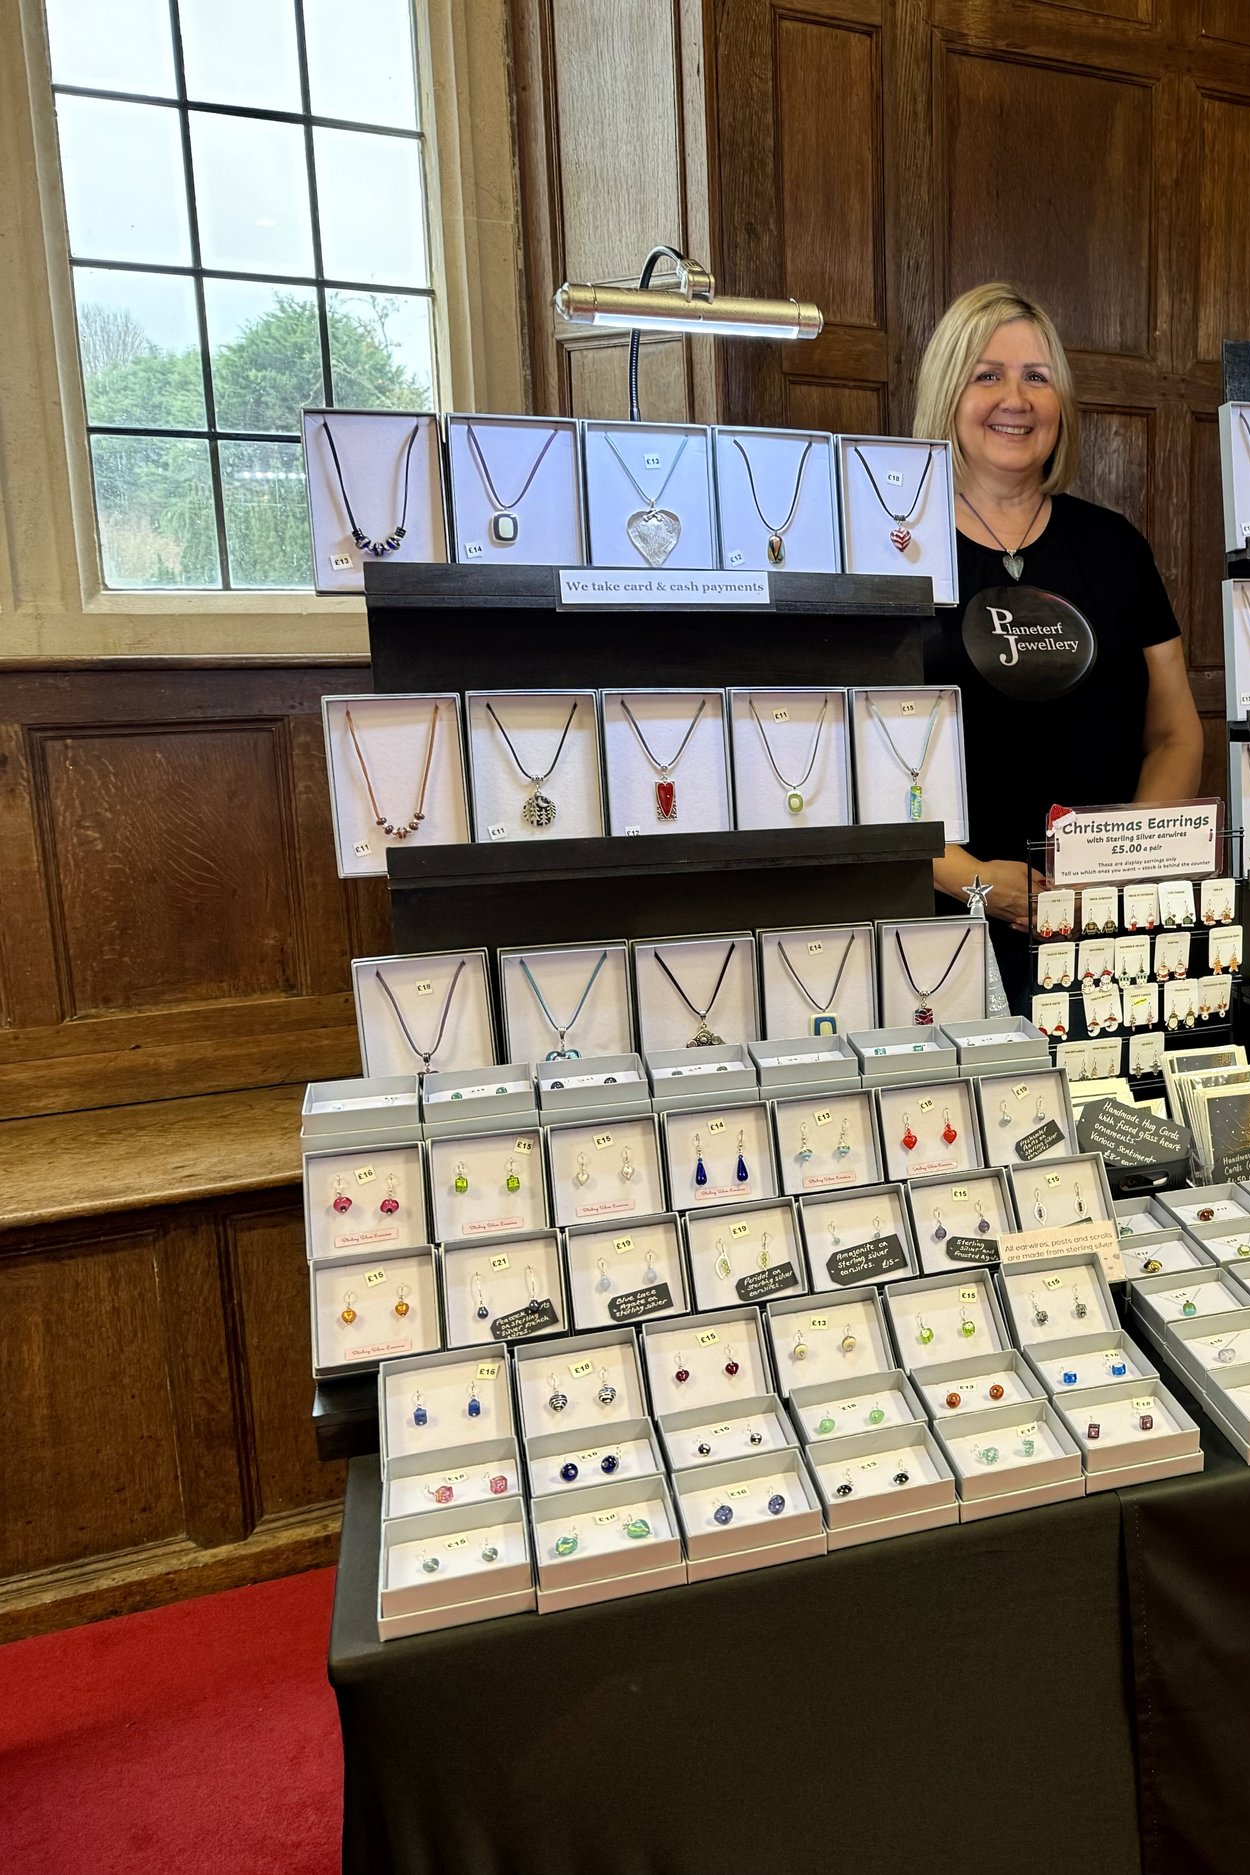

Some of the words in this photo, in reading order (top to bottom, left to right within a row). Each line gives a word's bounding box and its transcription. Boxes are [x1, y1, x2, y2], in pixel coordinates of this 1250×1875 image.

[646, 457, 661, 466] £13
[468, 545, 483, 554] £14
[334, 556, 350, 566] £13
[566, 580, 587, 593] We
[589, 580, 620, 593] take
[623, 580, 654, 592] card
[656, 580, 668, 592] &
[671, 580, 699, 592] cash
[702, 581, 765, 595] payments
[986, 606, 1063, 635] Planeterf
[999, 635, 1079, 666] Jewellery
[775, 711, 788, 720] £11
[1062, 820, 1142, 835] Christmas
[1148, 815, 1210, 829] Earrings
[491, 827, 506, 837] £11
[1087, 836, 1104, 844] with
[1106, 835, 1134, 844] Sterling
[1136, 833, 1155, 841] Silver
[1157, 831, 1187, 839] earwires
[355, 844, 371, 855] £11
[1111, 844, 1142, 855] £5.00
[1149, 844, 1162, 852] pair
[817, 1112, 832, 1123] £13
[1103, 1101, 1140, 1124] Handmade
[1142, 1118, 1156, 1134] Hug
[1159, 1126, 1180, 1140] Cards
[710, 1121, 725, 1131] £14
[1090, 1131, 1115, 1148] Various
[1115, 1120, 1138, 1136] fused
[1136, 1131, 1158, 1143] glass
[1159, 1138, 1181, 1151] heart
[517, 1141, 532, 1150] £15
[596, 1136, 611, 1146] £15
[1224, 1164, 1242, 1175] Cards
[358, 1170, 374, 1180] £16
[954, 1190, 967, 1198] £15
[616, 1240, 632, 1250] £19
[1004, 1245, 1014, 1253] All
[1051, 1238, 1072, 1247] posts
[1073, 1235, 1088, 1243] and
[1089, 1232, 1113, 1240] scrolls
[1022, 1251, 1045, 1259] made
[1046, 1249, 1065, 1257] from
[1066, 1244, 1093, 1254] sterling
[1094, 1241, 1113, 1249] silver
[492, 1257, 507, 1267] £21
[367, 1271, 384, 1282] £15
[962, 1292, 976, 1300] £15
[700, 1333, 716, 1343] £15
[479, 1367, 496, 1376] £16
